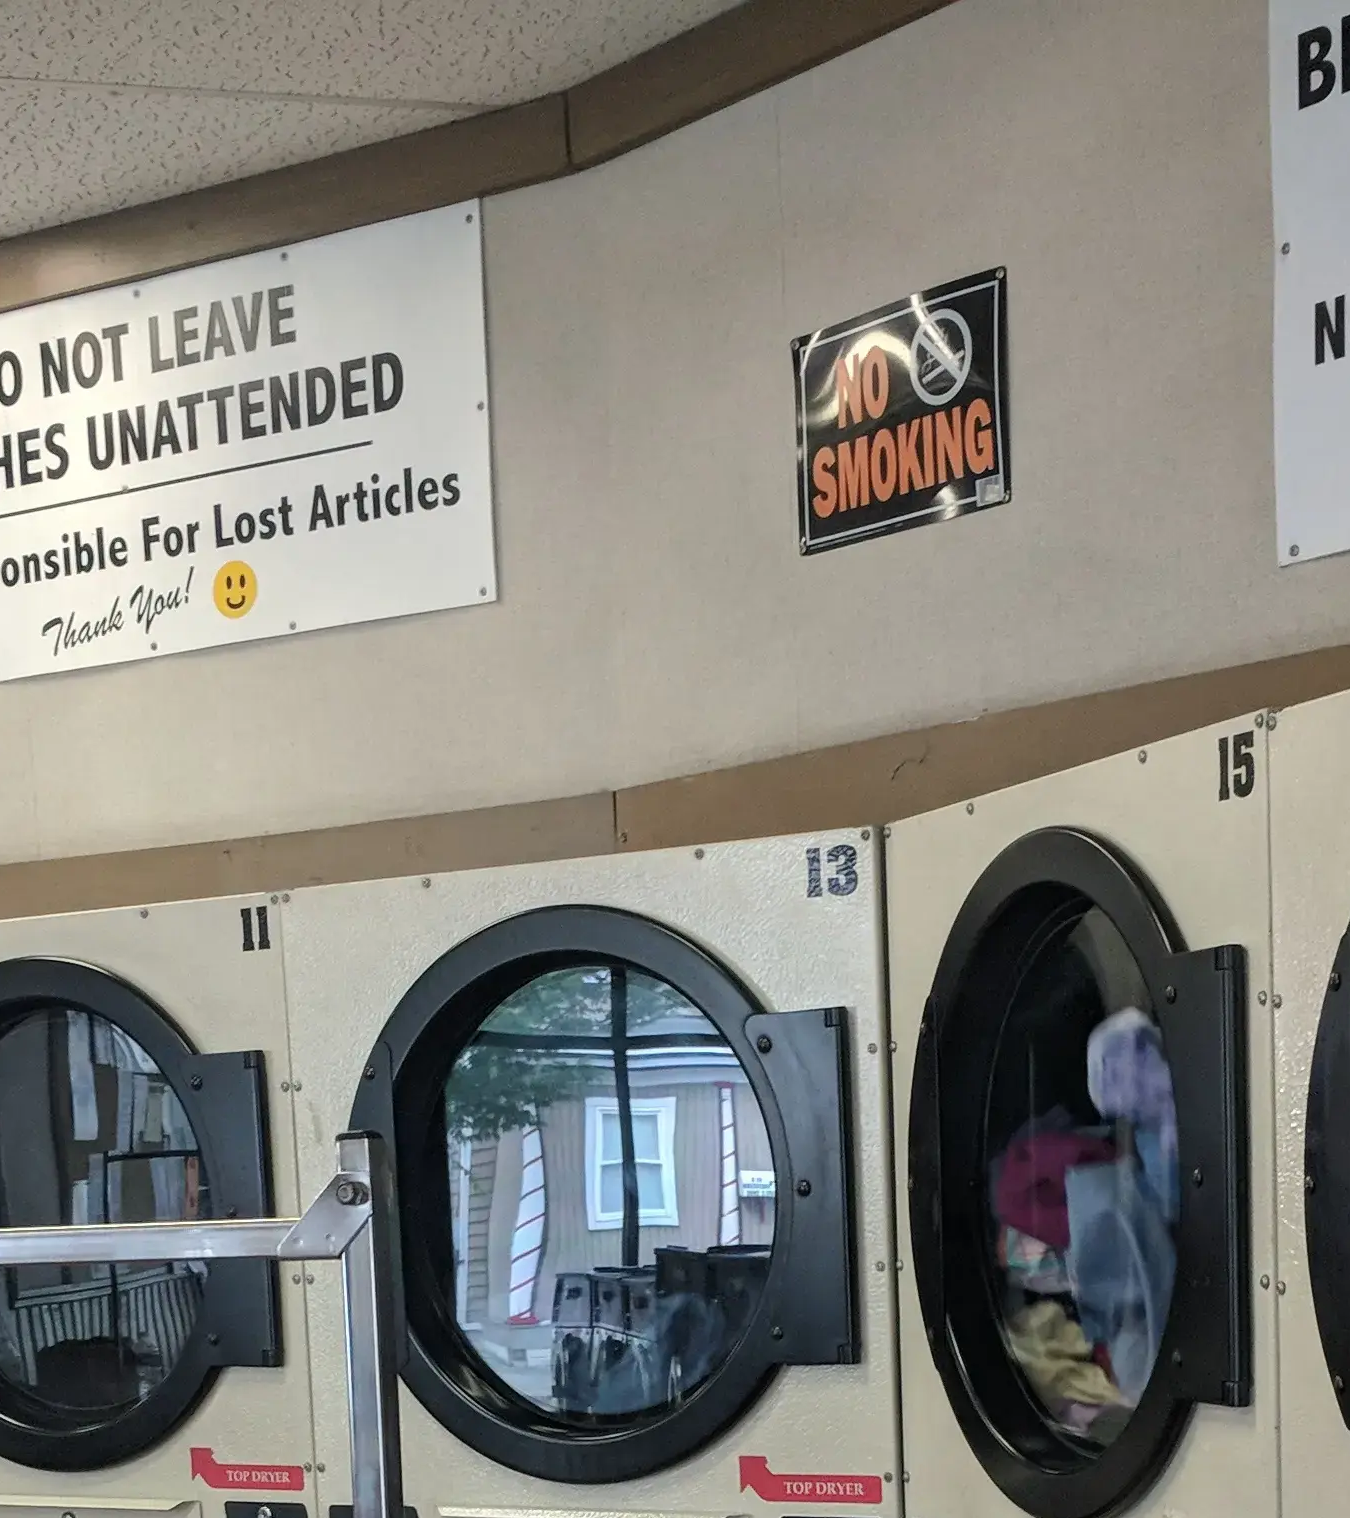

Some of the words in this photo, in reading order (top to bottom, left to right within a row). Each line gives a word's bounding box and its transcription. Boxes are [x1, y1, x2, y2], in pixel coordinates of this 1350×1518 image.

[40, 324, 130, 397] NOT
[148, 284, 297, 374] LEAVE
[87, 351, 404, 471] UNATTENDED
[836, 345, 889, 429] NO
[813, 397, 994, 519] SMOKING
[142, 515, 200, 561] For
[214, 496, 294, 551] Lost
[309, 467, 461, 533] Articles
[41, 607, 125, 656] Thank
[130, 566, 195, 629] You!
[1218, 730, 1255, 801] 15
[806, 844, 858, 898] 13
[240, 906, 270, 951] 11
[226, 1470, 249, 1481] TOP
[252, 1471, 290, 1483] DRYER
[784, 1480, 813, 1496] TOP
[816, 1481, 864, 1497] DRYER
